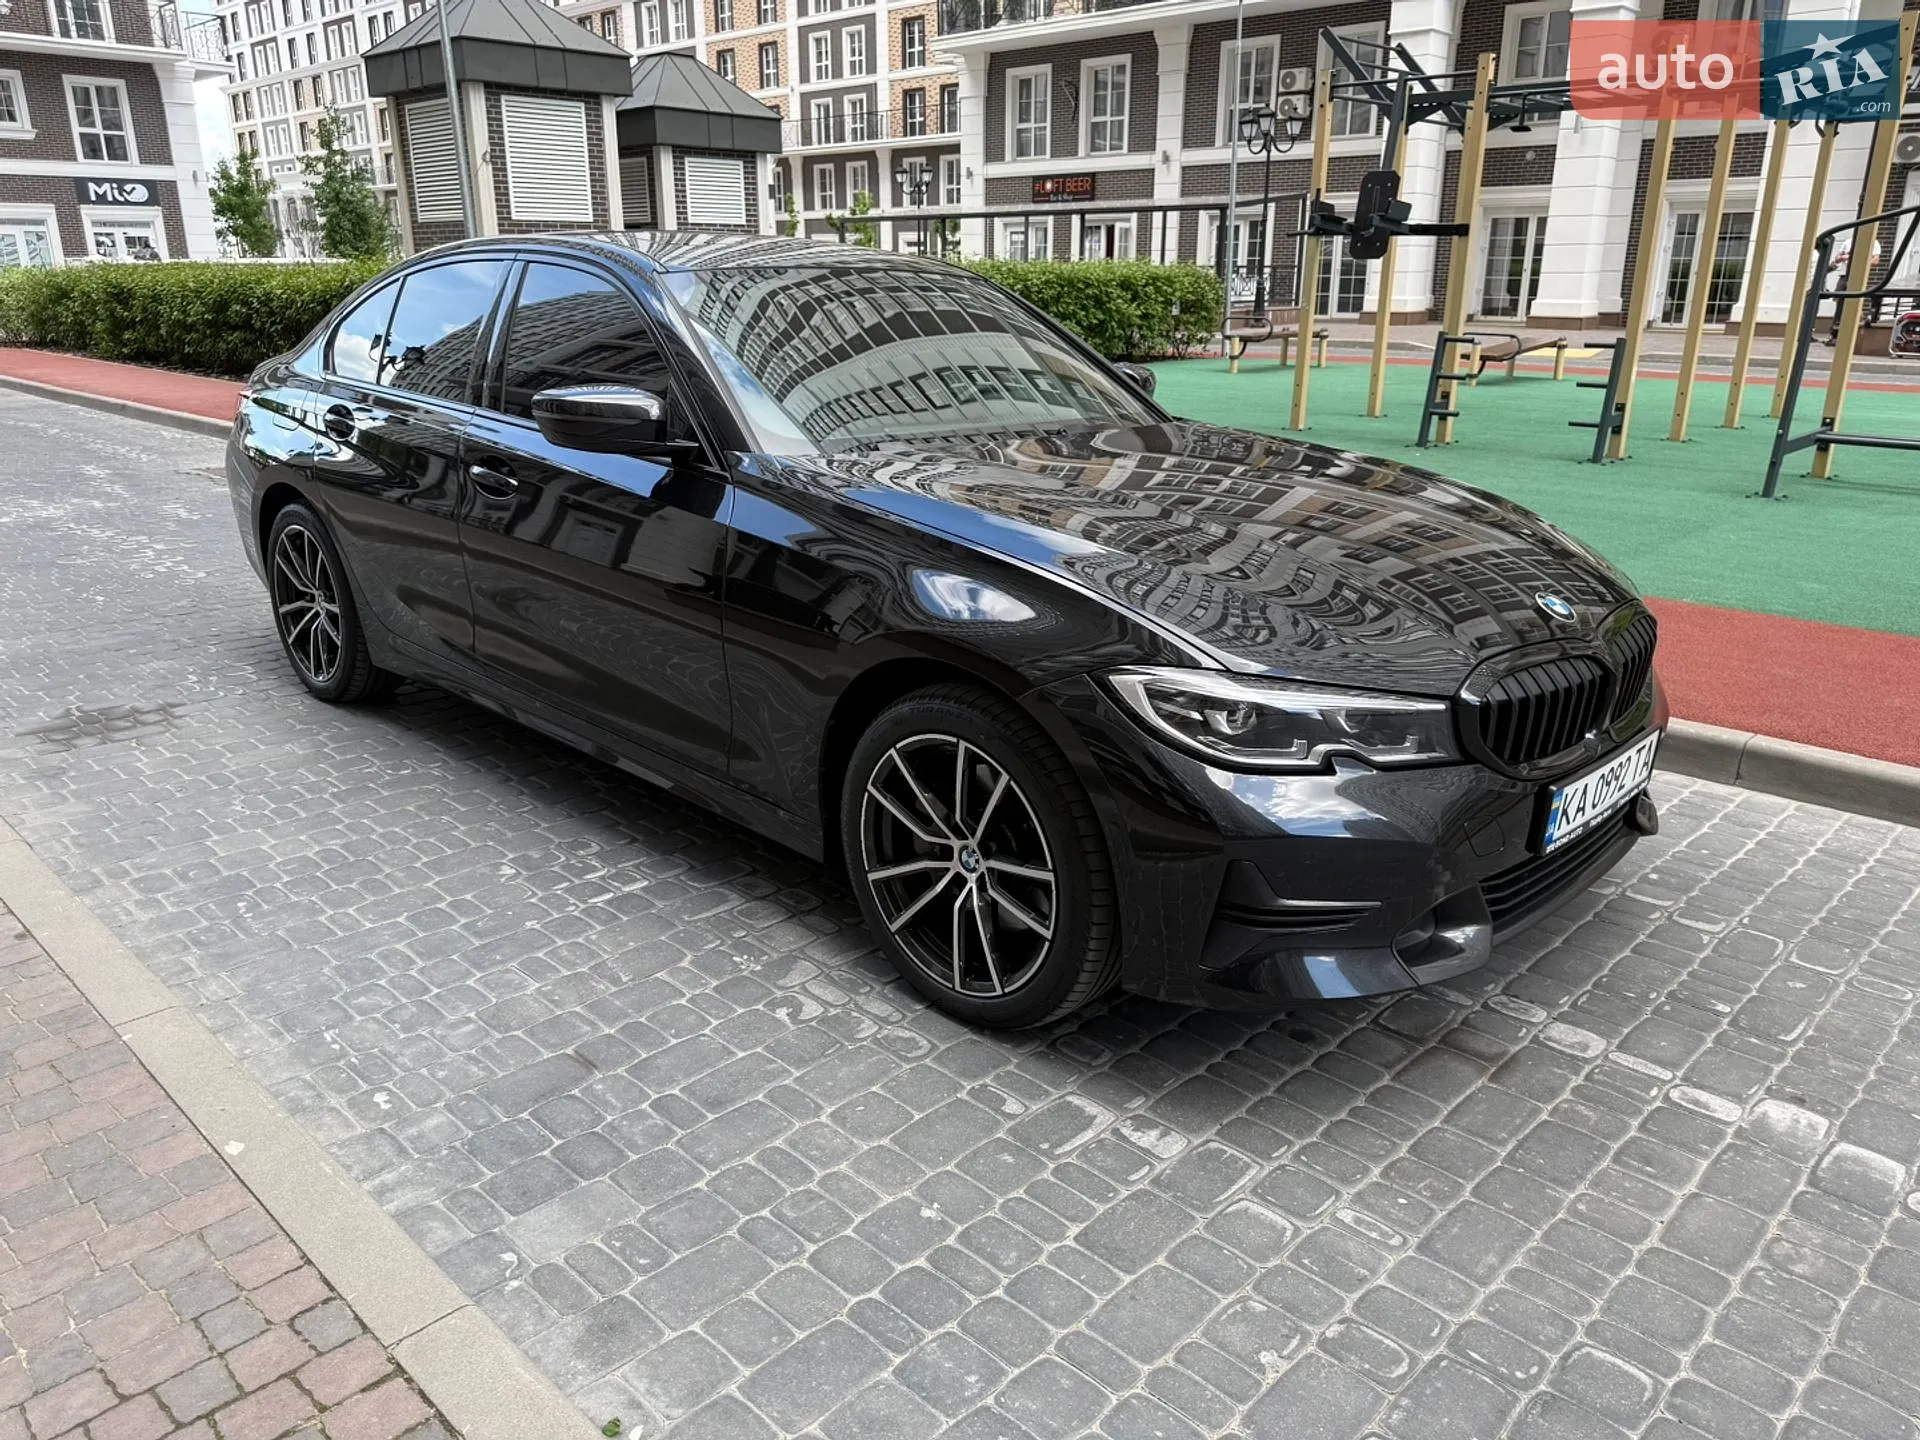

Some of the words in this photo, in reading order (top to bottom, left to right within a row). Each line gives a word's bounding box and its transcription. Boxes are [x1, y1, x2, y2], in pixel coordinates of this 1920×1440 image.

[1066, 176, 1091, 192] BEER
[1557, 782, 1589, 832] KA
[1592, 755, 1632, 811] 0992
[1633, 740, 1654, 781] TA
